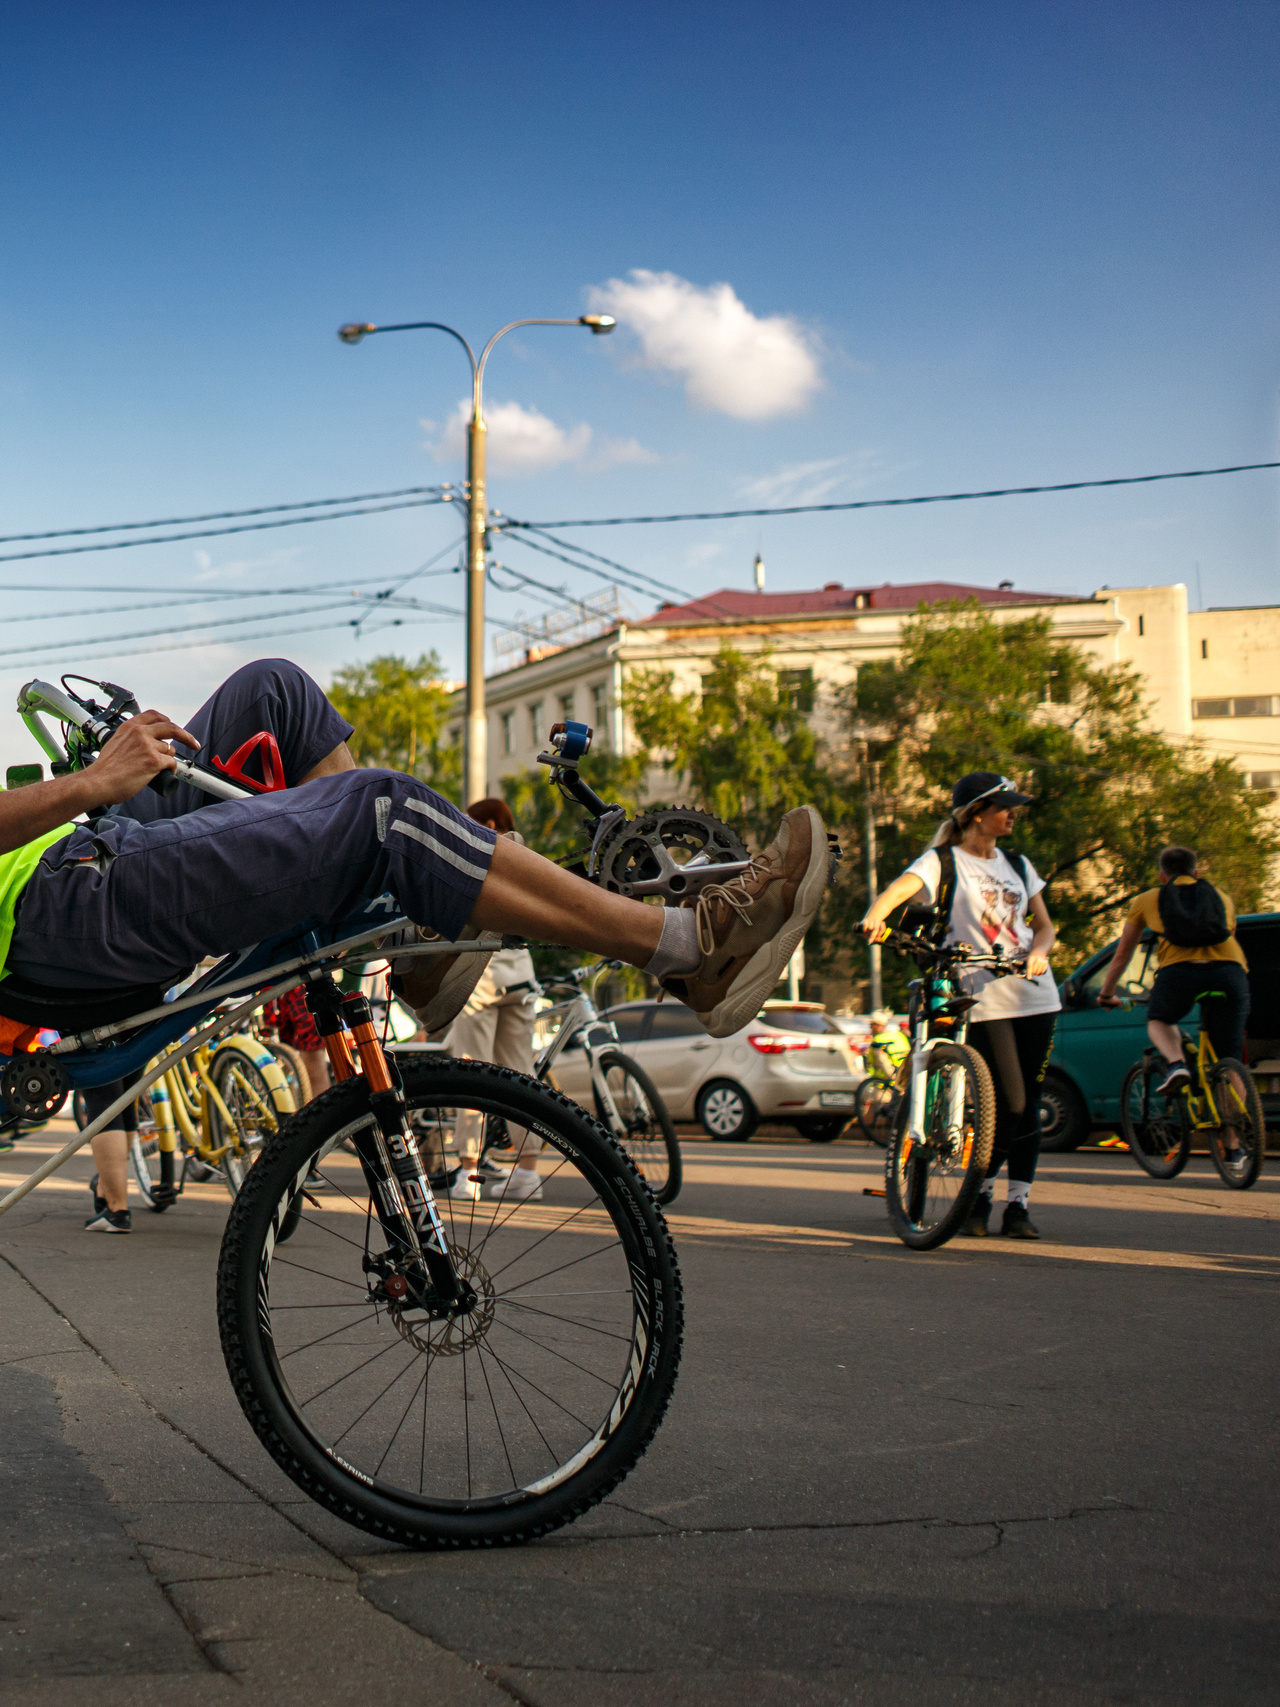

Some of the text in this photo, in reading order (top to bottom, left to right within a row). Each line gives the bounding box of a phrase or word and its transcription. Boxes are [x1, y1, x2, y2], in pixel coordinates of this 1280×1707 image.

[531, 1121, 581, 1158] ALEXRIMS
[613, 1175, 665, 1380] SCHWALBE BLACK JACK
[325, 1447, 375, 1486] ALEXRIMS
